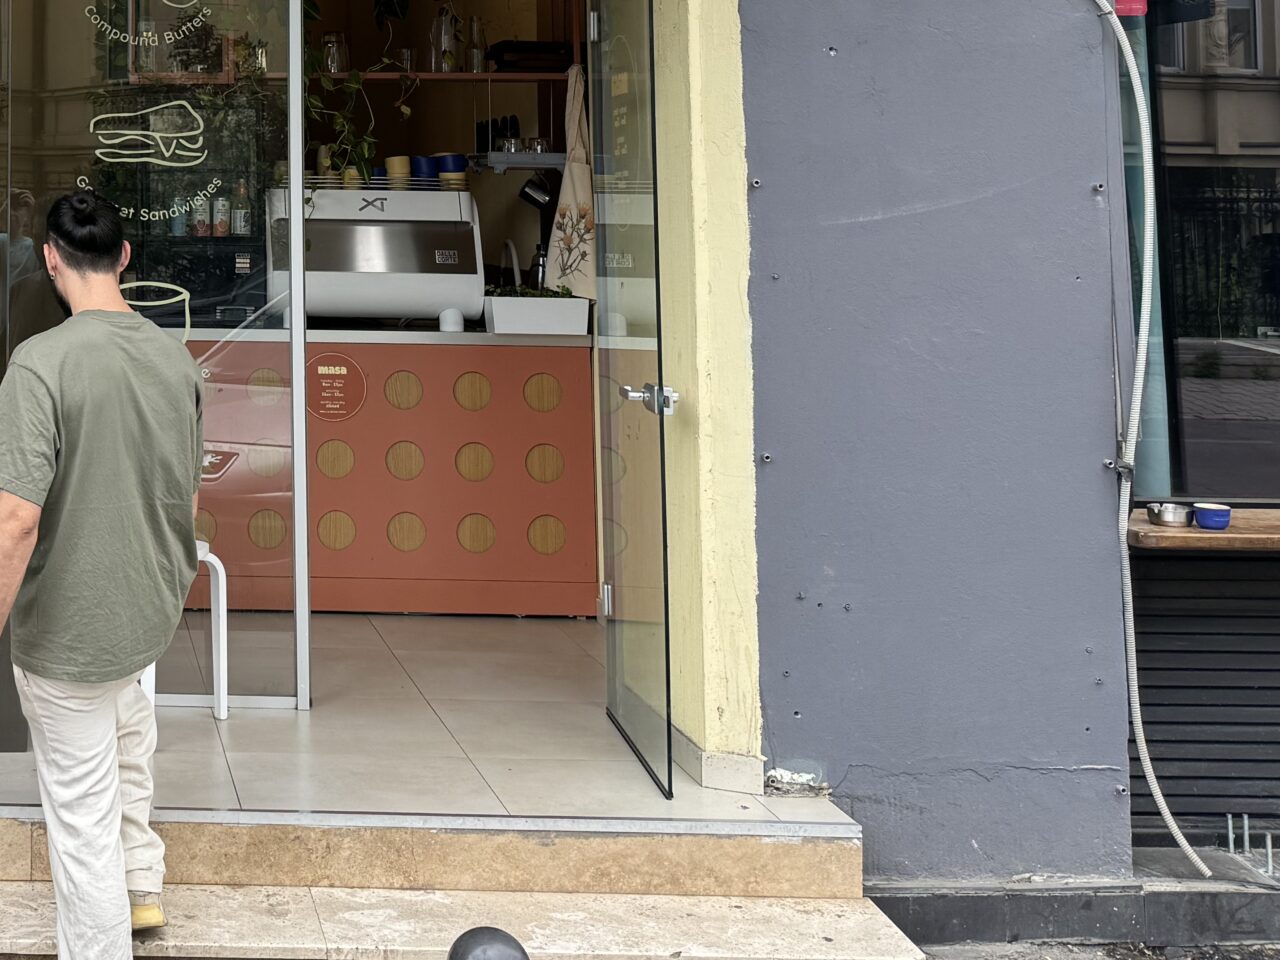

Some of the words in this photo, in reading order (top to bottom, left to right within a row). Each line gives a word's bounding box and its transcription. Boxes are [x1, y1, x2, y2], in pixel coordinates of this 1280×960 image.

[85, 6, 159, 47] Compound
[164, 6, 212, 44] Butters
[140, 178, 222, 221] Sandwiches
[317, 365, 348, 375] masa
